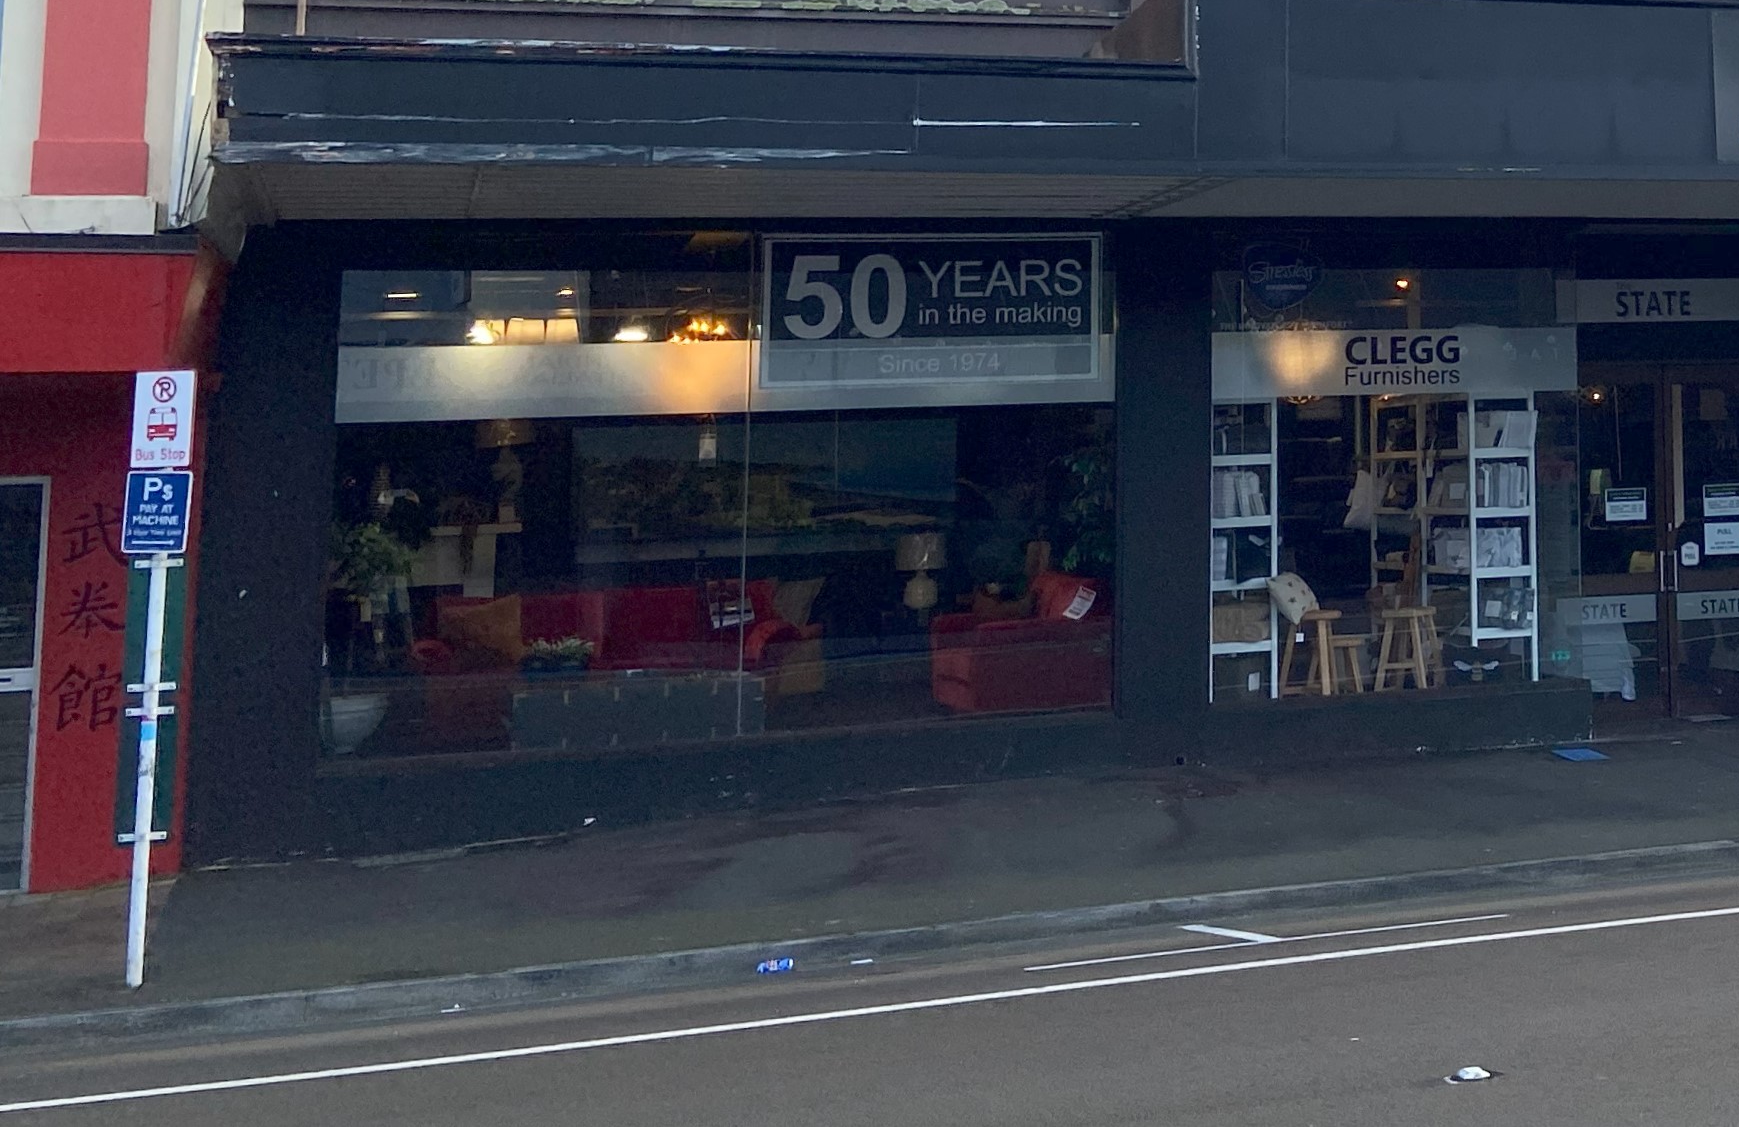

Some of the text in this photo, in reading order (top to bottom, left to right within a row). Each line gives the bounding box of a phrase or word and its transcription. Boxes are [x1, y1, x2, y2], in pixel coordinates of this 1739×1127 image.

[783, 253, 1083, 339] 50 YEARS
[1616, 291, 1691, 317] STATE
[919, 301, 1082, 327] in the making
[1345, 335, 1460, 365] CLEGG
[879, 353, 1000, 374] Since 1974
[1345, 366, 1460, 386] Furnishers
[136, 448, 186, 462] Bus Stop
[139, 503, 174, 514] PAY AT
[132, 515, 179, 526] MACHINE
[1582, 603, 1627, 620] STATE
